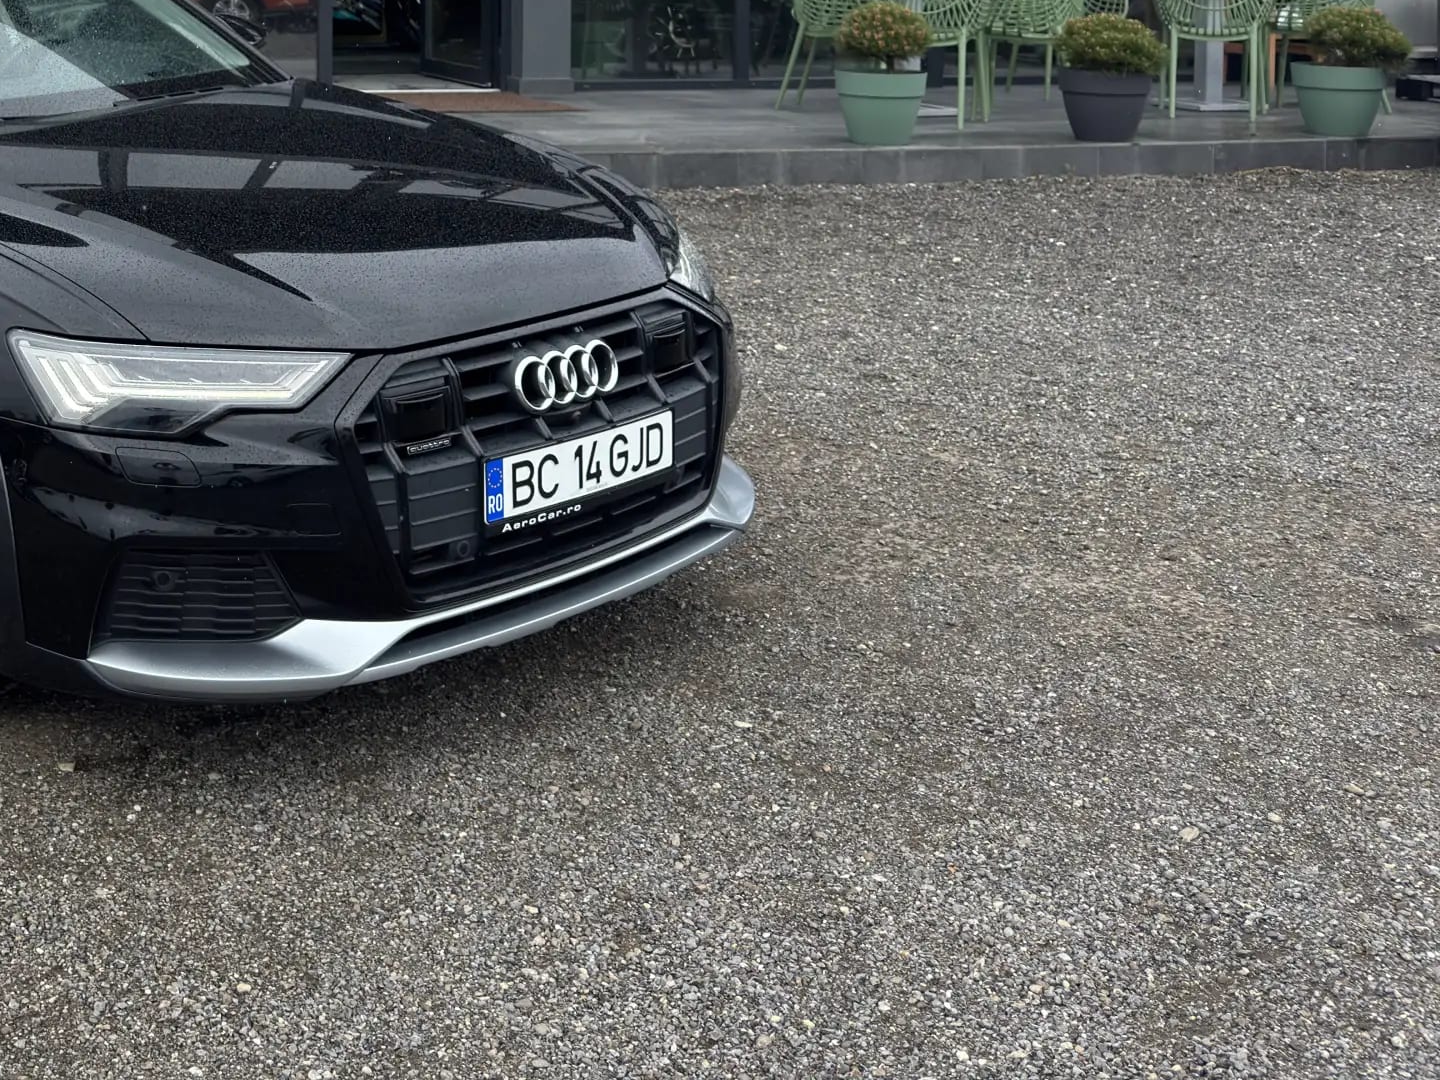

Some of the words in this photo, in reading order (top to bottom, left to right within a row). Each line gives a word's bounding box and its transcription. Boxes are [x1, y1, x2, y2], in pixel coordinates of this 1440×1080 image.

[409, 439, 450, 453] quattro
[511, 453, 559, 509] BC
[574, 440, 602, 489] 14
[610, 422, 663, 478] GJD
[488, 493, 503, 515] RO
[502, 504, 582, 533] AeroCar.ro
